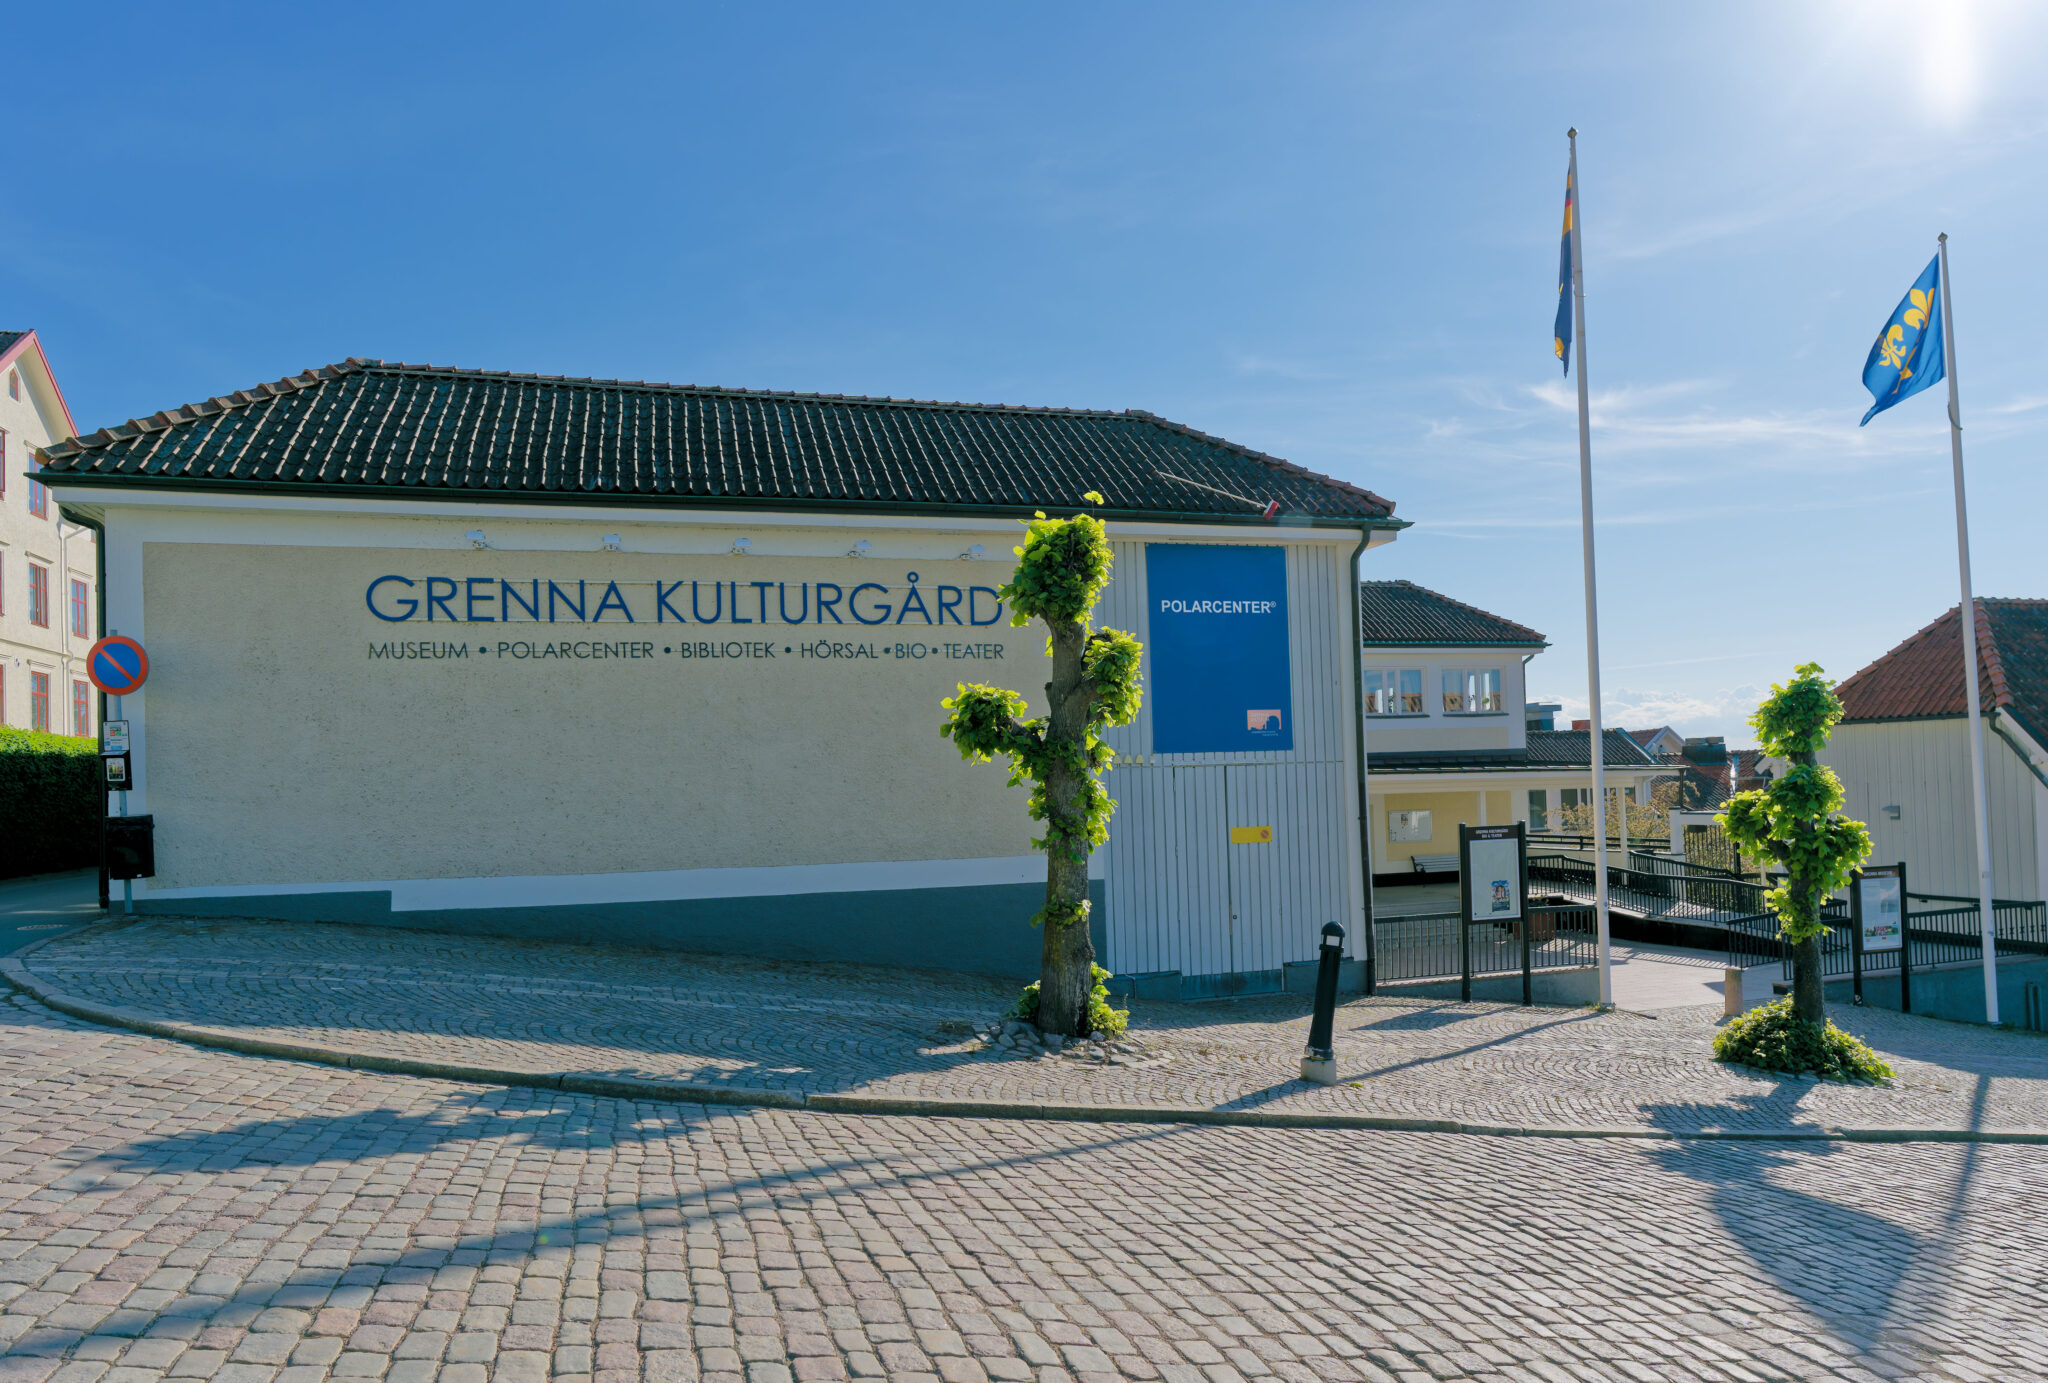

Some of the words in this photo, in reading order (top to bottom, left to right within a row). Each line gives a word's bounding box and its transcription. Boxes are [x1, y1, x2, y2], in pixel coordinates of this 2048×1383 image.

[366, 574, 635, 623] GRENNA
[656, 571, 1004, 626] KULTURGÅRD
[367, 641, 469, 660] MUSEUM
[498, 641, 654, 659] POLARCENTER
[681, 641, 776, 659] BIBLIOTEK
[801, 639, 879, 659] HÖRSAL
[895, 642, 927, 659] BIO
[944, 643, 1004, 659] TEATER
